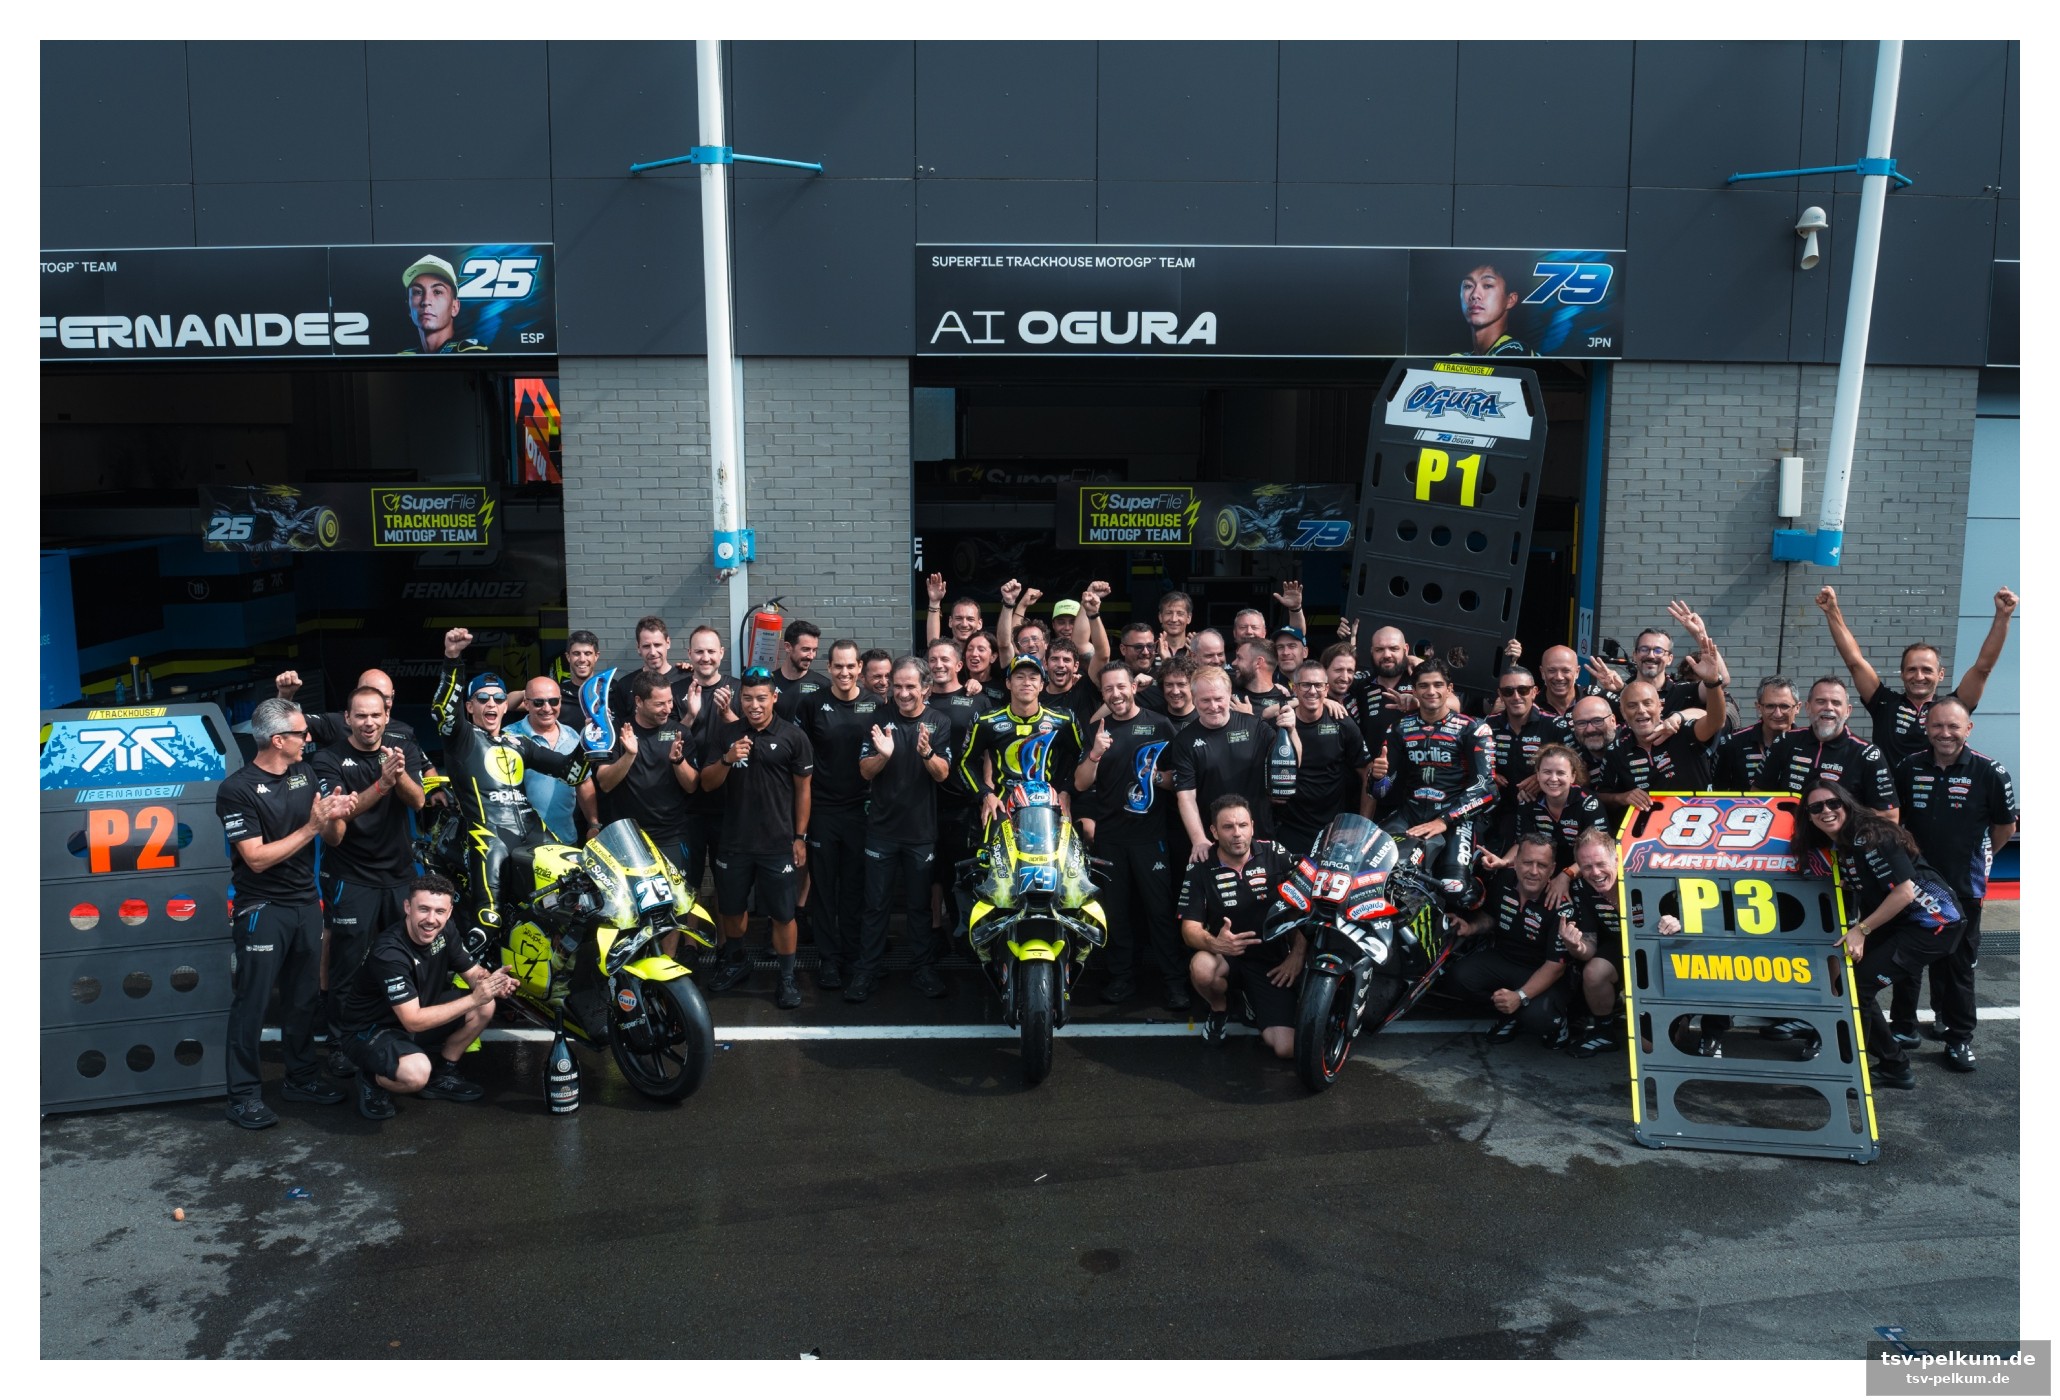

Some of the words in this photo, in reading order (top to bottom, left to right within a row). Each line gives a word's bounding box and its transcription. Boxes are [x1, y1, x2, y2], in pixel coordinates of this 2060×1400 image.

[81, 261, 117, 272] TEAM
[931, 256, 1004, 267] SUPERFILE
[1005, 257, 1093, 268] TRACKHOUSE
[1159, 257, 1196, 269] TEAM
[459, 256, 541, 300] 25
[1521, 262, 1613, 305] 79
[930, 311, 1005, 344] AI
[1018, 311, 1218, 345] OGURA
[520, 332, 545, 344] ESP
[1587, 336, 1612, 349] JPN
[1442, 363, 1485, 375] TRACKHOUSE
[1404, 382, 1505, 420] OGURA
[1451, 437, 1474, 446] OGURA
[525, 426, 547, 482] OTUL
[207, 513, 257, 543] 25
[383, 514, 477, 529] TRACKHOUSE
[1090, 513, 1182, 528] TRACKHOUSE
[440, 528, 478, 542] TEAM
[1145, 528, 1181, 541] TEAM
[1289, 519, 1351, 548] 79
[401, 578, 527, 600] FERNÁNDEZ
[1581, 612, 1591, 636] 11
[99, 708, 156, 719] TRACKHOUSE
[1408, 746, 1452, 765] aprilia
[1821, 762, 1844, 773] aprilia
[1948, 776, 1972, 785] aprilia
[88, 786, 171, 800] FERNANDEZ
[1457, 796, 1484, 815] aprilia
[1659, 805, 1775, 849] 89
[89, 806, 176, 874] P2
[1319, 859, 1351, 871] TARGA
[1649, 851, 1799, 872] MARTINATOR
[1245, 866, 1266, 877] aprilia
[1018, 865, 1058, 896] 79
[635, 876, 673, 911] 25
[1282, 883, 1307, 910] sterilgarda
[1274, 900, 1288, 912] sky
[1350, 900, 1385, 918] sterilgarda
[1373, 919, 1392, 930] sky
[1670, 952, 1813, 984] VAMOOOS
[618, 995, 636, 1006] Gulf
